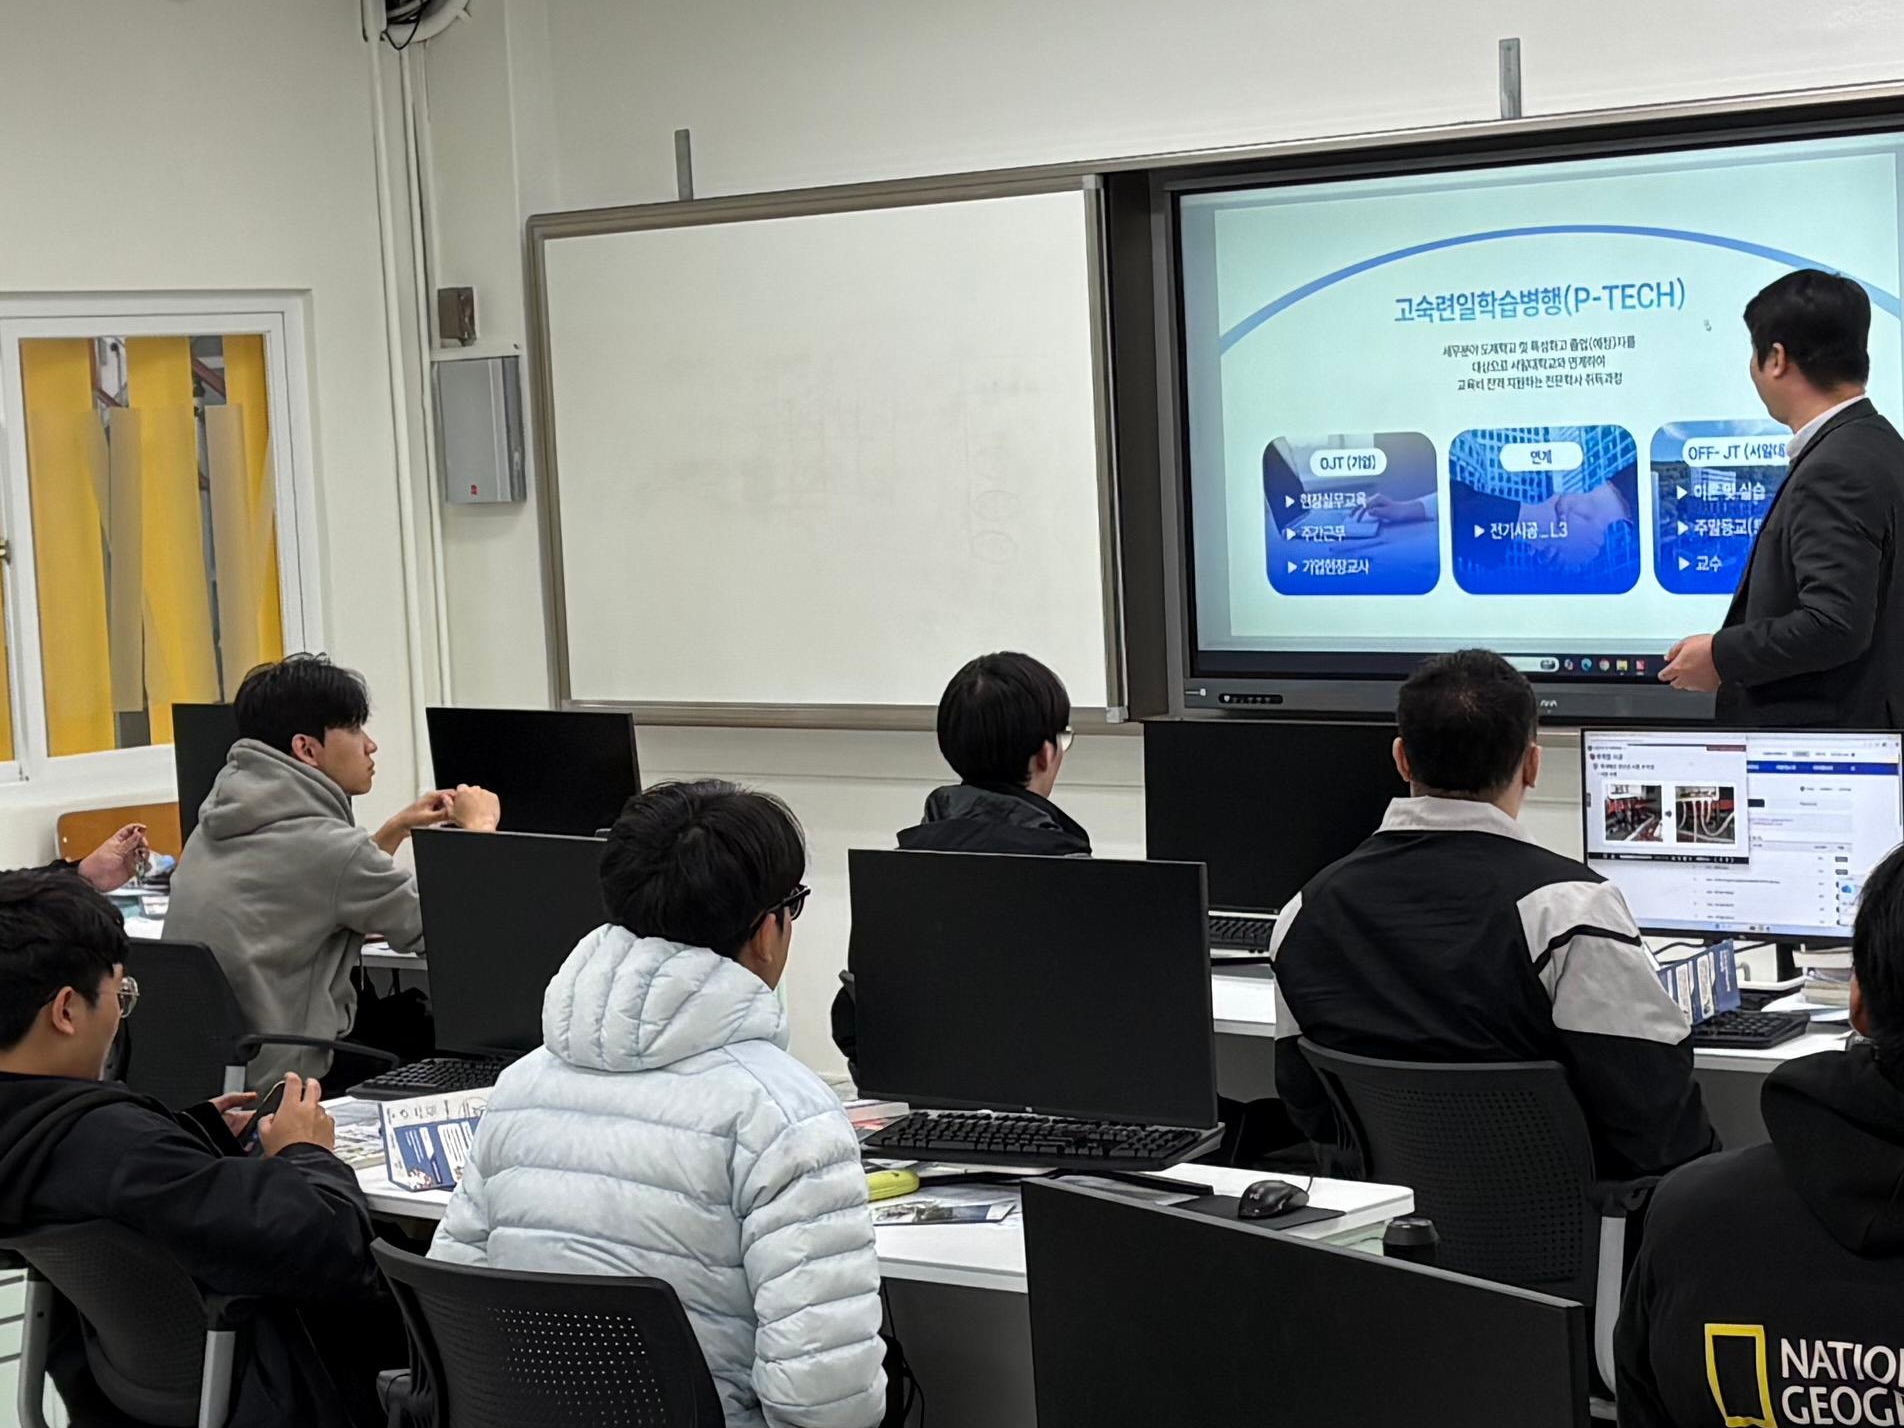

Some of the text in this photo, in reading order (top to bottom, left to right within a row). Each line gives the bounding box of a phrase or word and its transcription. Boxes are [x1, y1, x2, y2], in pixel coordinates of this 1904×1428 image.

[1394, 277, 1686, 323] 고숙련일학습병행(P-TECH)
[1320, 454, 1377, 471] OJT (기업)
[1302, 558, 1370, 576] 기업현장교사
[1694, 556, 1723, 573] 교수
